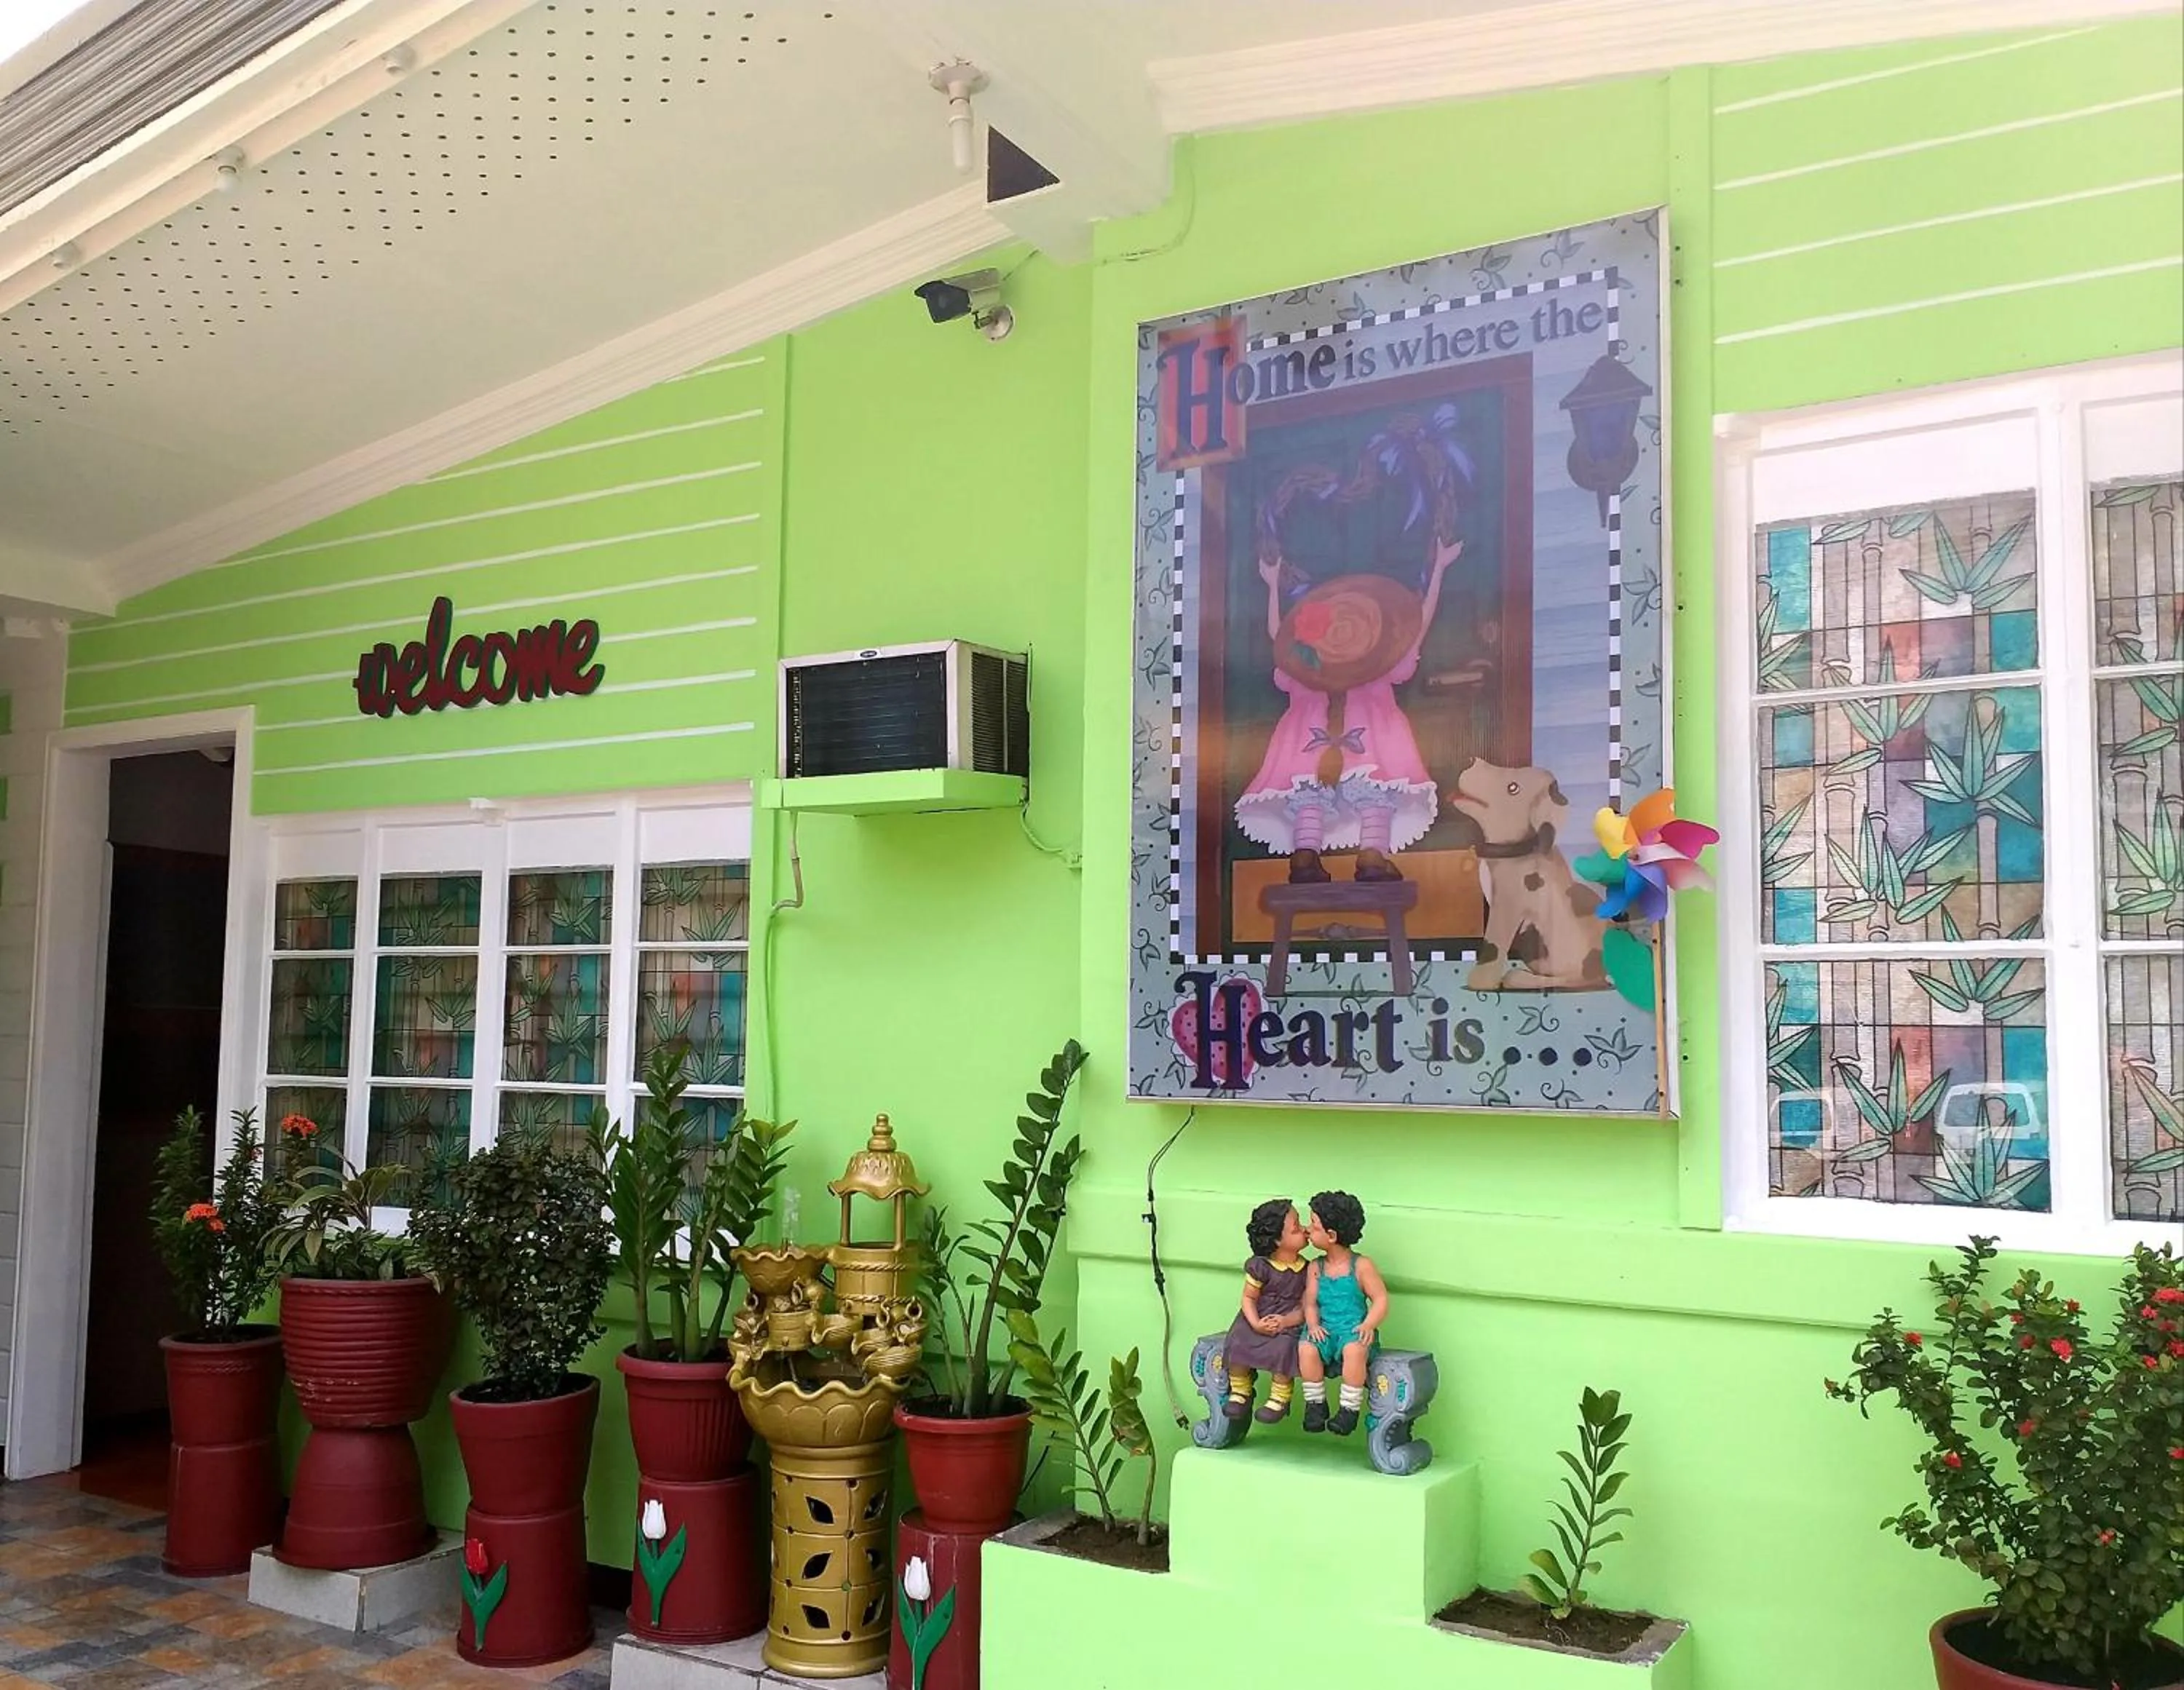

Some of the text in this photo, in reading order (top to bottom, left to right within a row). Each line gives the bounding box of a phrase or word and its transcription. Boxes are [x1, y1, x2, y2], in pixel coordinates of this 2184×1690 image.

[1157, 297, 1603, 458] Home is where the
[1174, 969, 1404, 1090] Heart
